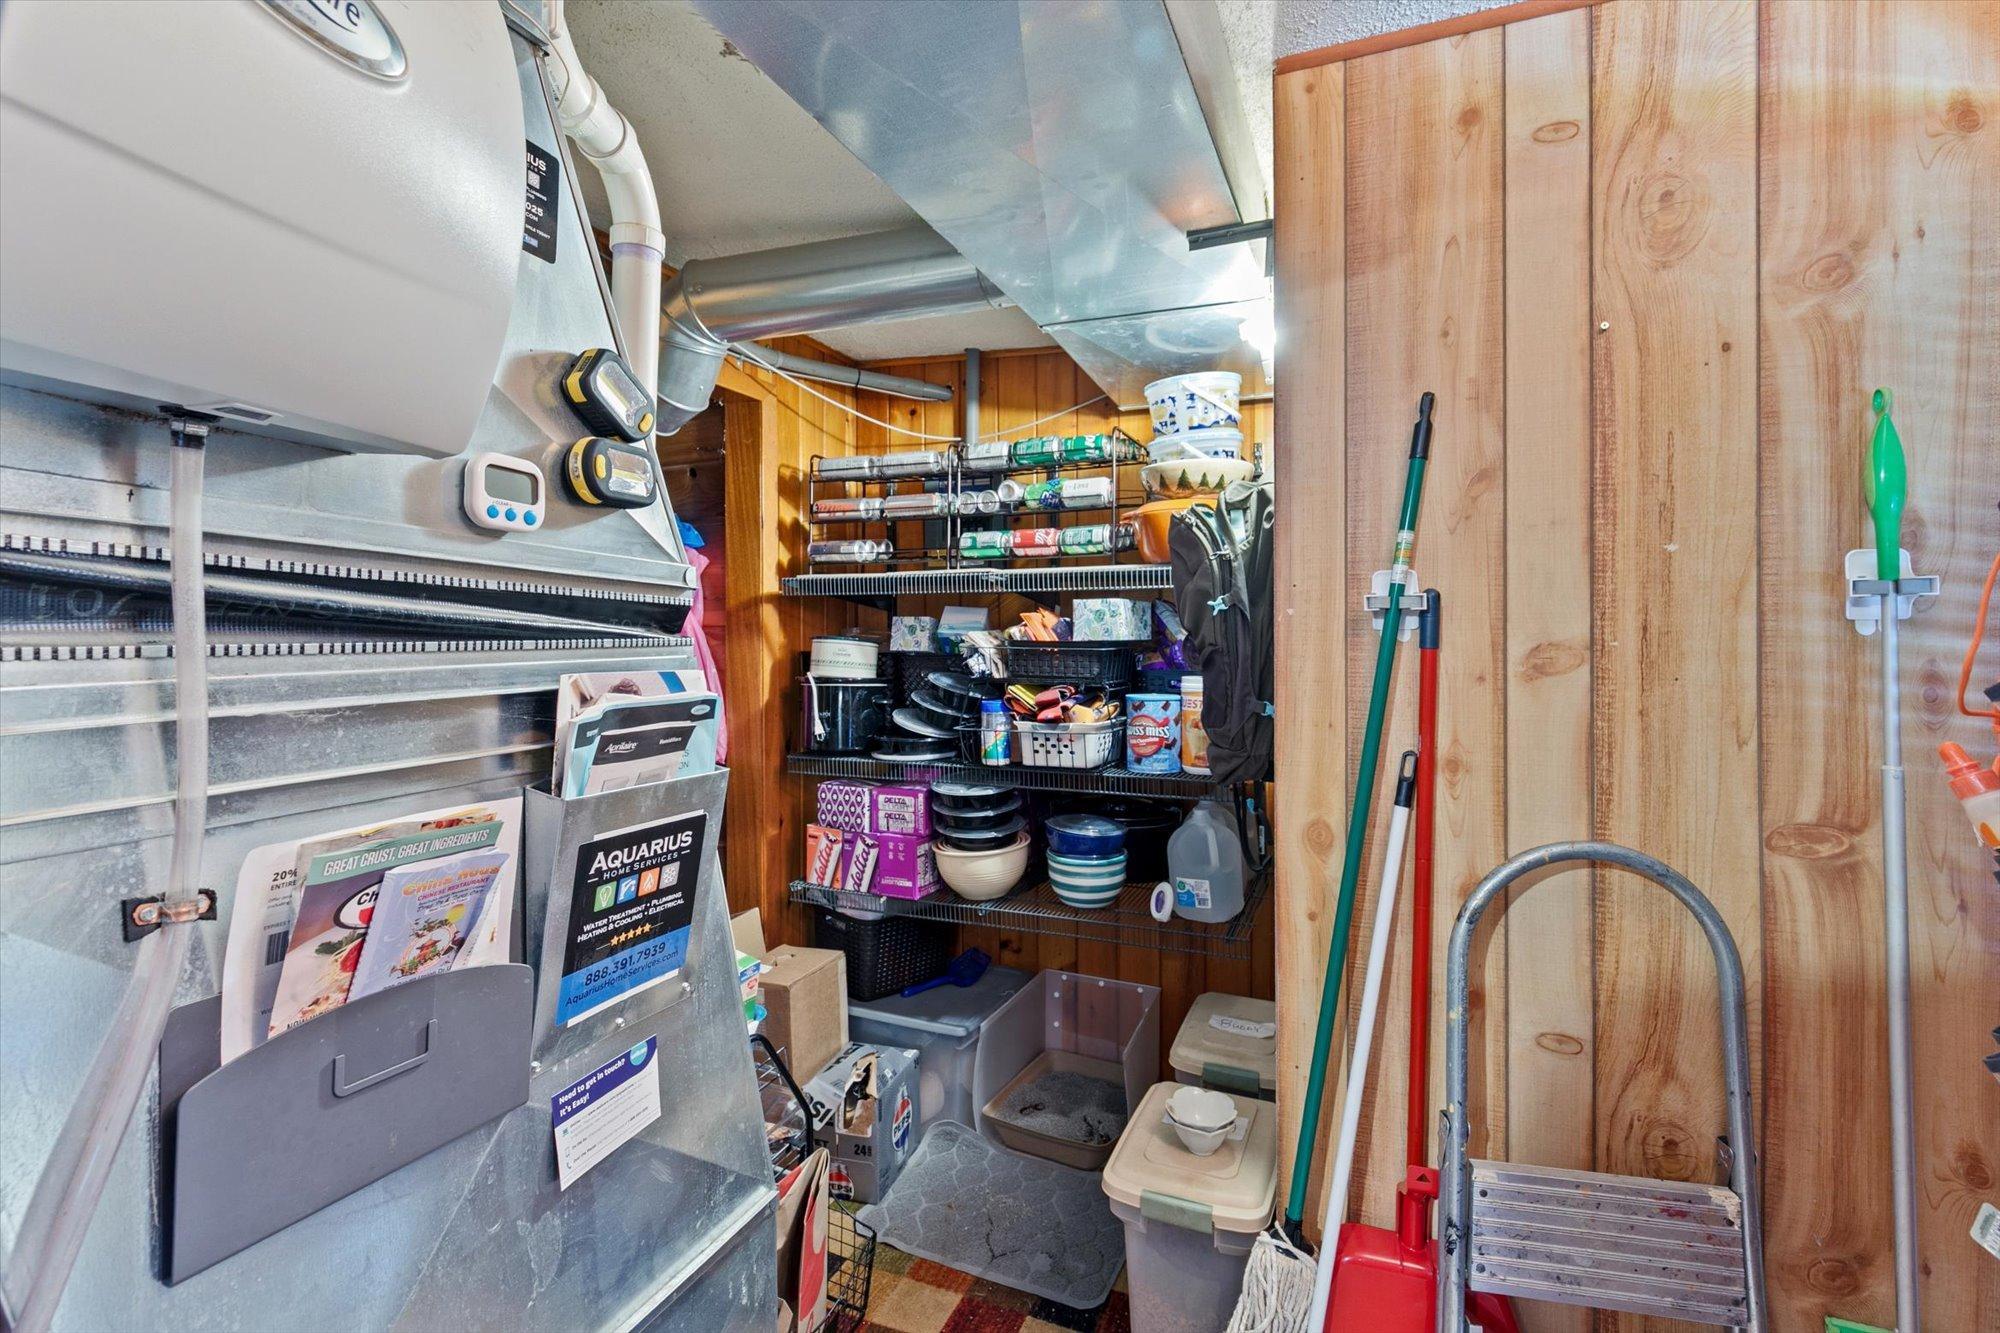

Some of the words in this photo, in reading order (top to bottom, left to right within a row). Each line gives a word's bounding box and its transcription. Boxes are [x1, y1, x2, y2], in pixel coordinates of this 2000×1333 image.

[323, 855, 359, 876] GREAT
[359, 848, 397, 868] CRUST,
[397, 838, 432, 859] GREAT
[430, 829, 490, 852] INGREDIENTS
[588, 831, 693, 875] AQUARIUS
[603, 866, 631, 880] HOME
[633, 851, 678, 871] SERVICES
[270, 879, 298, 892] ENTIRE
[272, 868, 299, 882] 20%
[577, 928, 608, 943] HEATING
[608, 924, 614, 932] &
[614, 913, 643, 928] COOLING
[648, 898, 685, 915] ELECTRICAL
[583, 918, 608, 932] WATER
[608, 904, 647, 923] TREATMENT
[651, 892, 682, 906] PLUMBING
[565, 950, 679, 1008] AquariusHomeServices.com
[584, 942, 666, 987] 888.391.7939
[558, 1086, 577, 1106] Need
[577, 1083, 585, 1093] to
[585, 1077, 597, 1091] get
[597, 1072, 605, 1080] in
[604, 1058, 626, 1077] touch?
[559, 1104, 573, 1118] It's
[572, 1092, 590, 1109] Easy!
[892, 1110, 912, 1138] PEPSI
